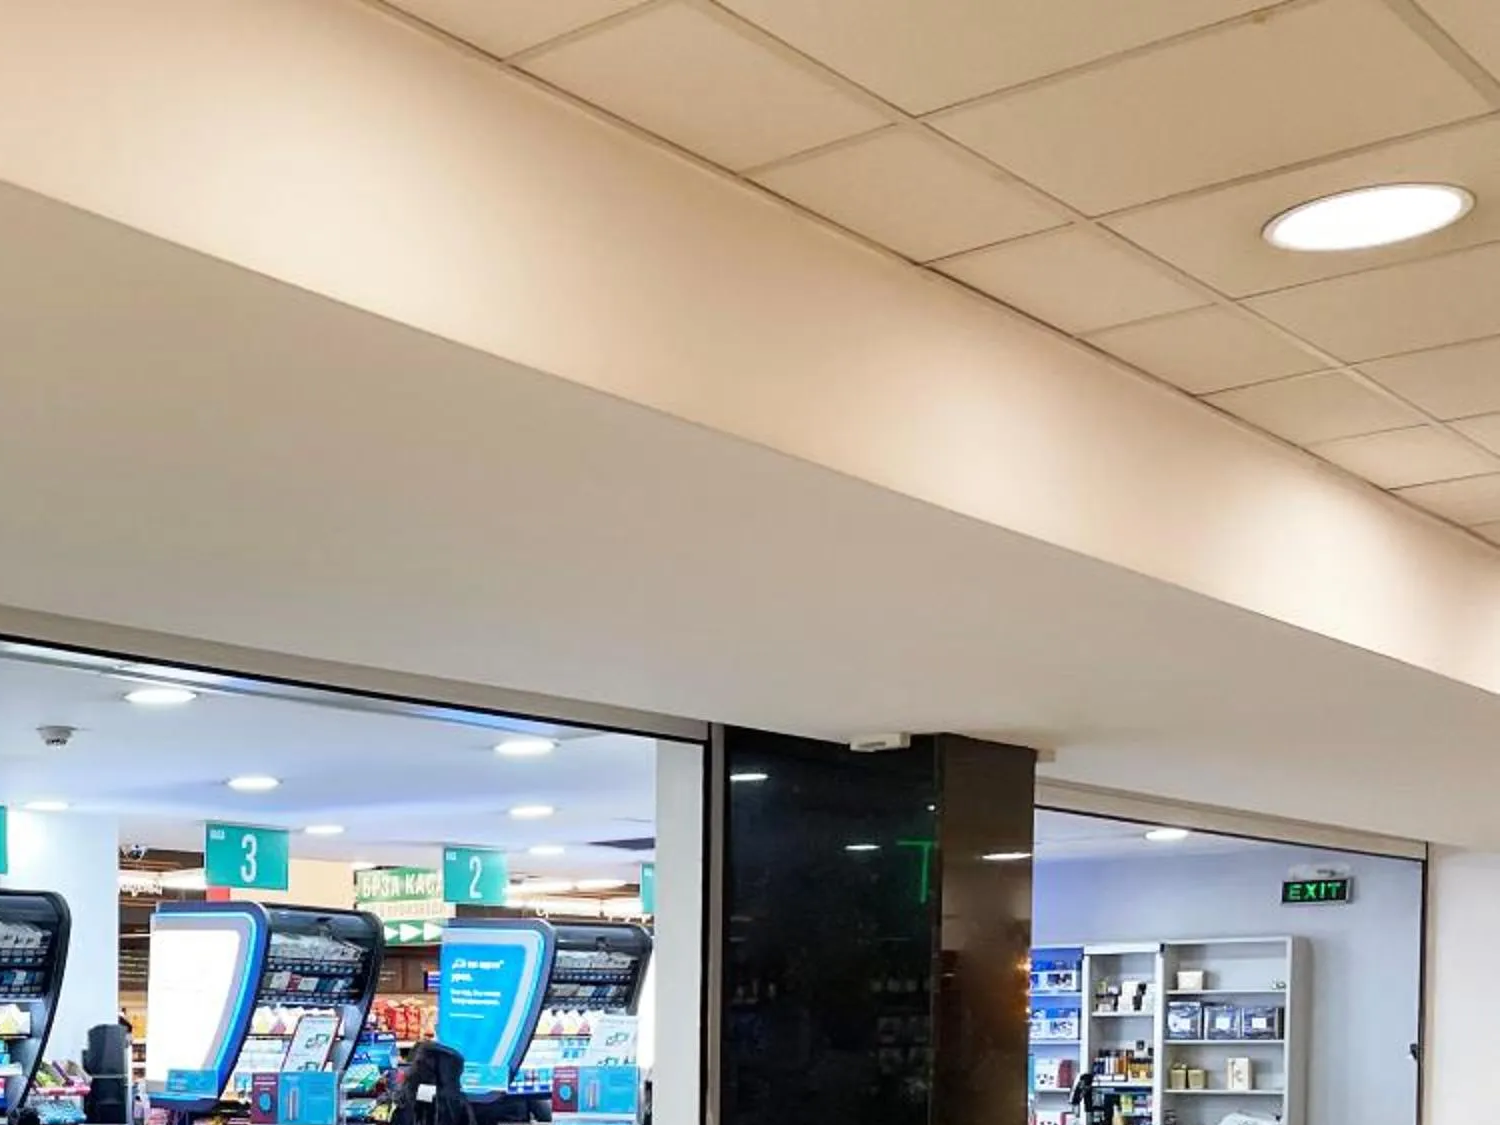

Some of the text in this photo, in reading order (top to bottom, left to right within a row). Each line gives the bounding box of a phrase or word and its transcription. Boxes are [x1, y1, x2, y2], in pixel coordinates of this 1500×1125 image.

[240, 833, 257, 884] 3
[405, 873, 443, 895] КАС
[469, 855, 483, 899] 2
[1288, 882, 1342, 900] EXIT
